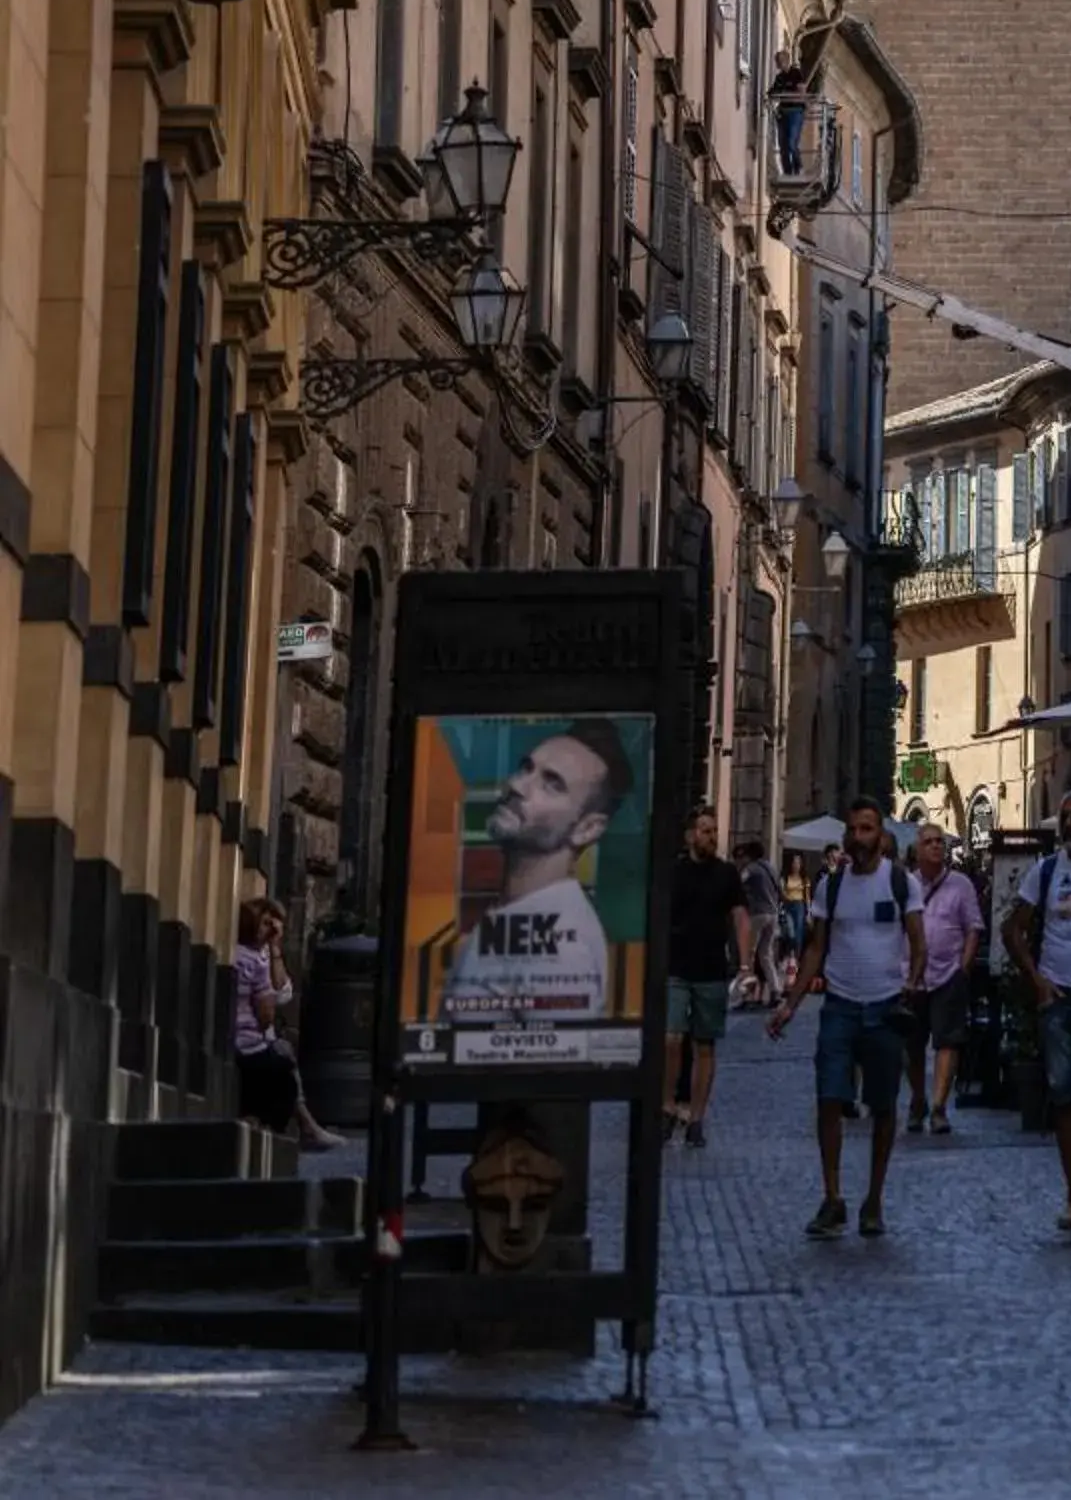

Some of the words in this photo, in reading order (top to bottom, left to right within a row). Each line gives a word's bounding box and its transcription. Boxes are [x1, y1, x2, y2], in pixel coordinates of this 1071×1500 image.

[479, 913, 560, 955] NEK
[533, 928, 578, 944] LIVE
[445, 995, 536, 1012] EUROPEAN
[491, 1033, 558, 1047] ORVIETO
